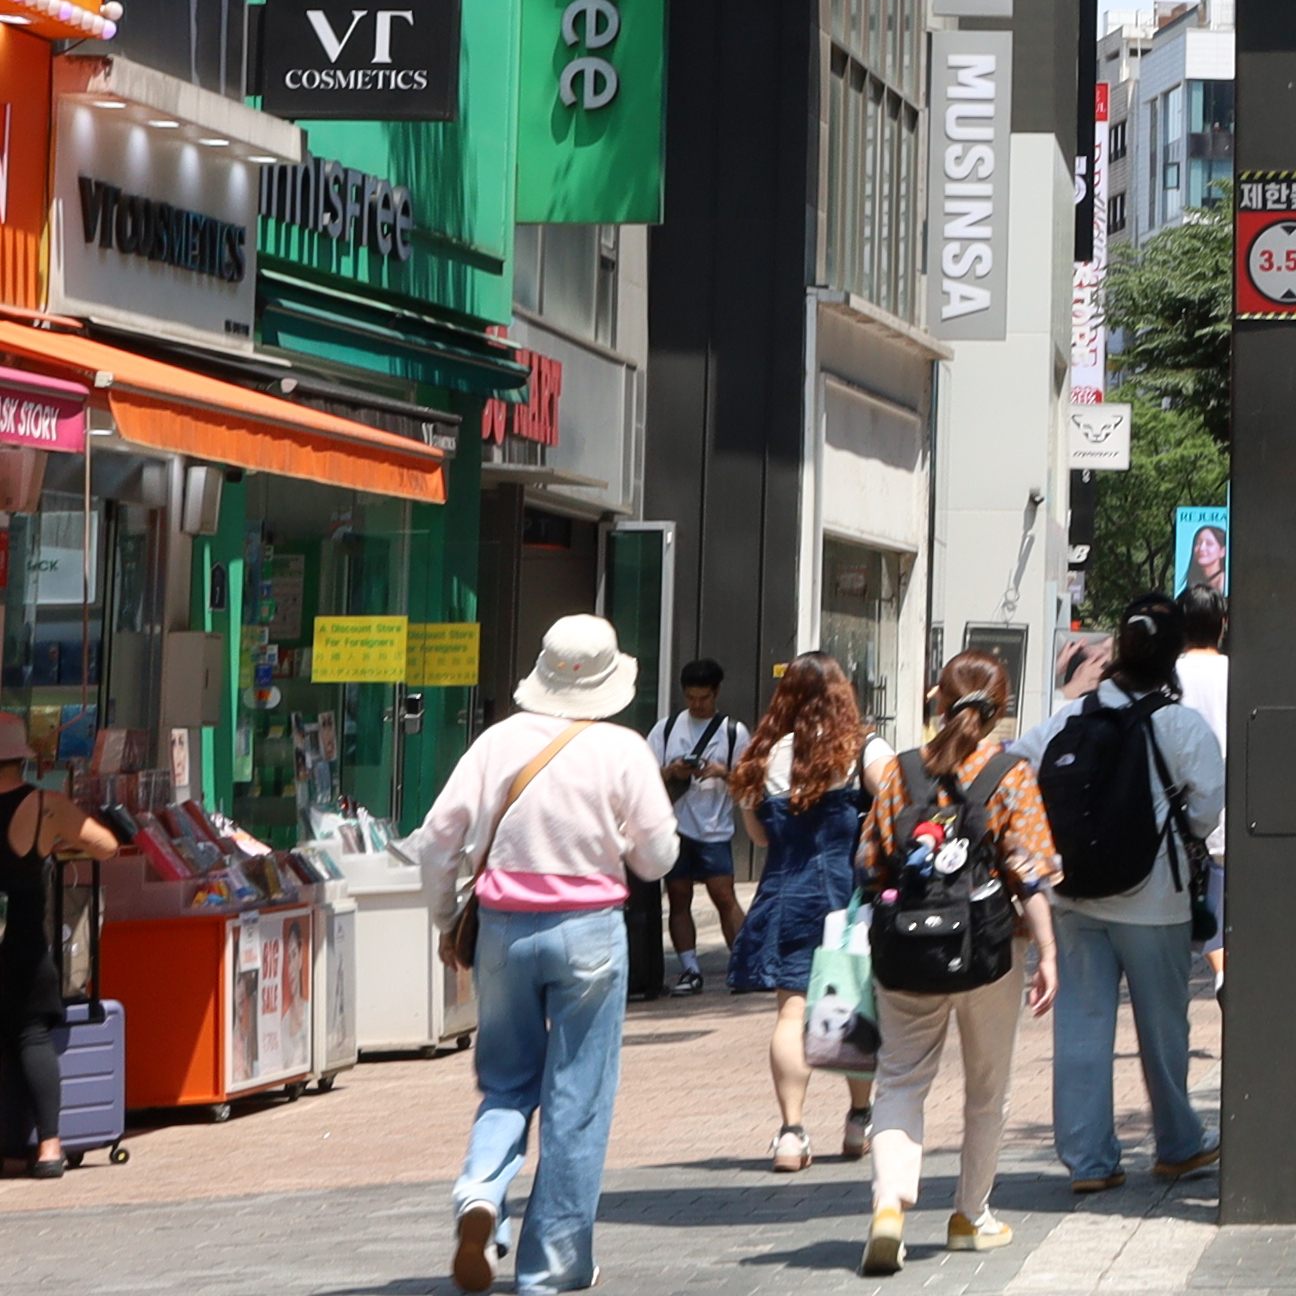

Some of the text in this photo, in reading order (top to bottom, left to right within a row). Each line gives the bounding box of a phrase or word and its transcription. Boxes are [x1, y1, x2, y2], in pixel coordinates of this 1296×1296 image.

[306, 9, 414, 64] VT
[284, 68, 428, 91] COSMETICS
[940, 53, 997, 322] MUSINSA
[18, 400, 60, 441] STORY
[263, 939, 279, 981] BIG
[262, 984, 278, 1016] SALE
